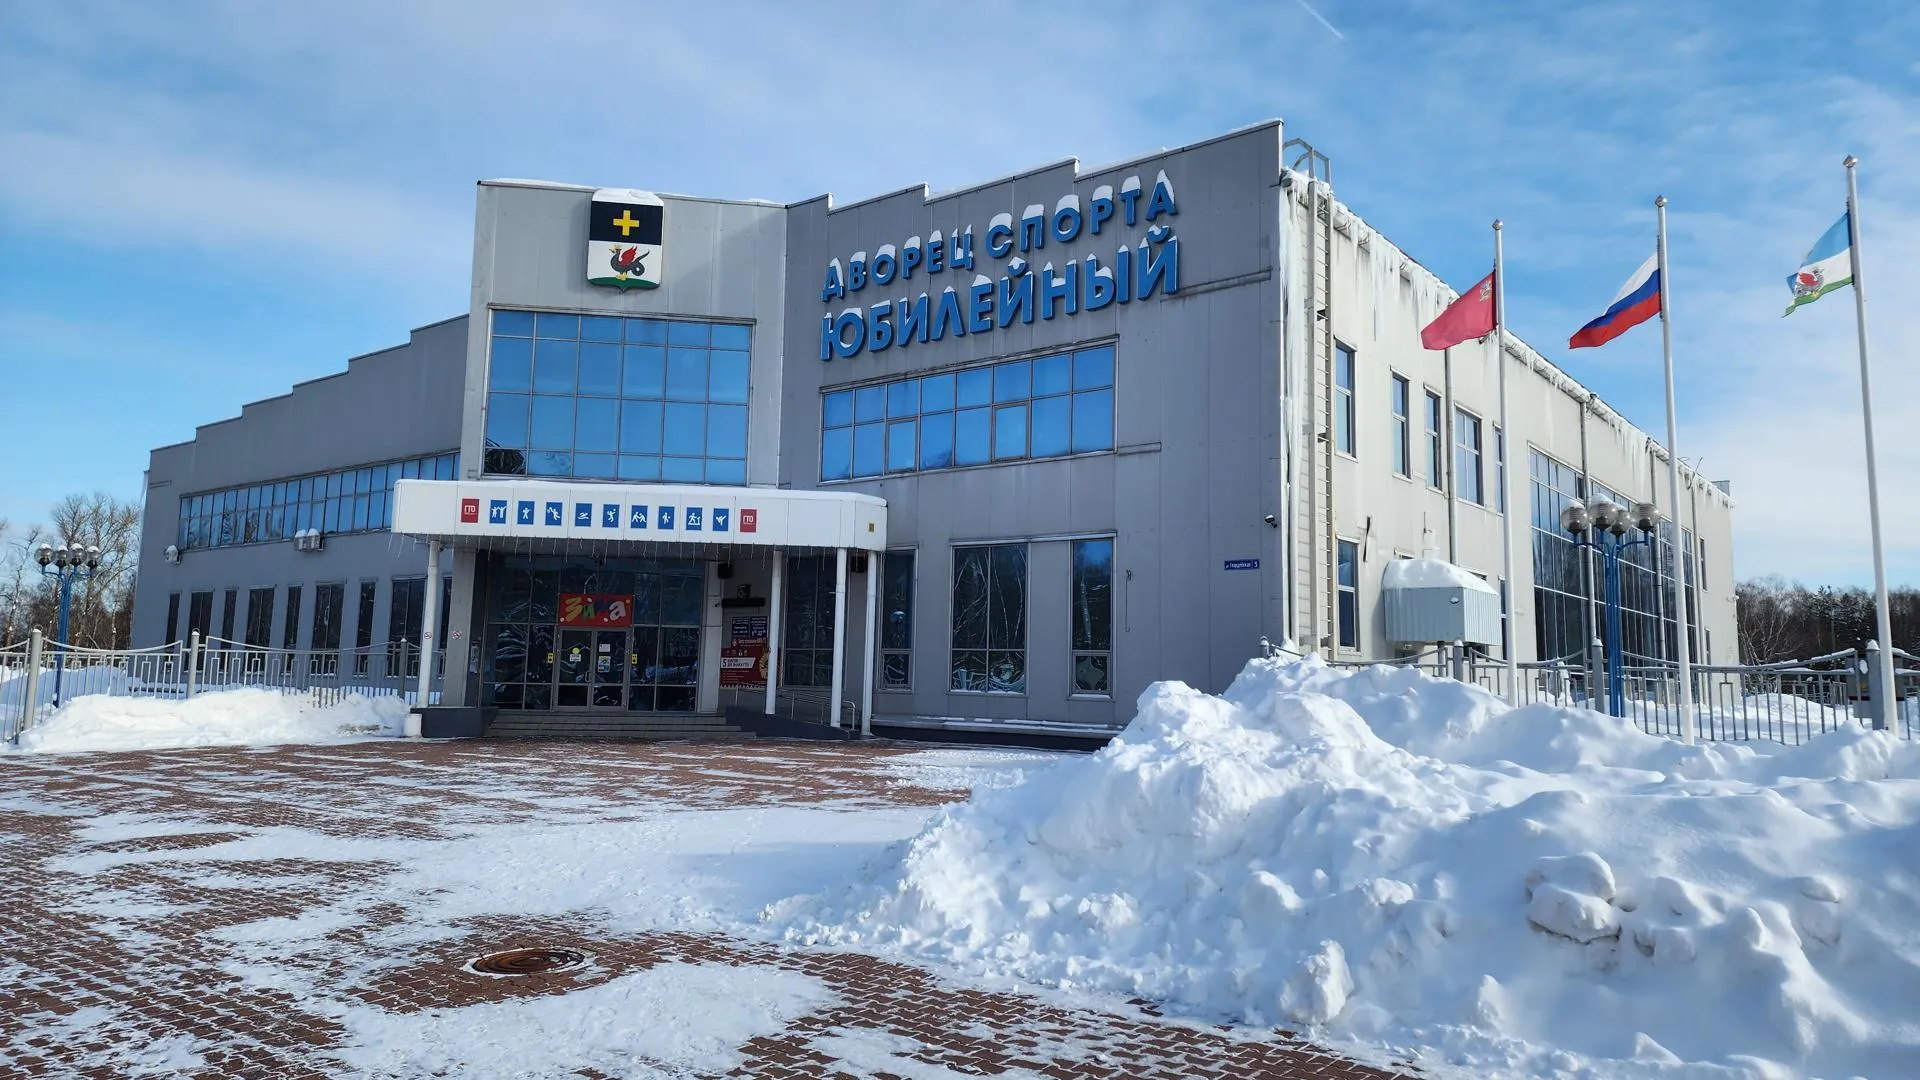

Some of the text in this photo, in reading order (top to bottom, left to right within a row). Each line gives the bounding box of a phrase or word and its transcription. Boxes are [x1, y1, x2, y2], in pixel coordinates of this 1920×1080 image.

[820, 225, 1180, 361] ЮБИЛЕЙНЫЙ
[821, 172, 1179, 302] ДВОРЕЦ СПОРТА
